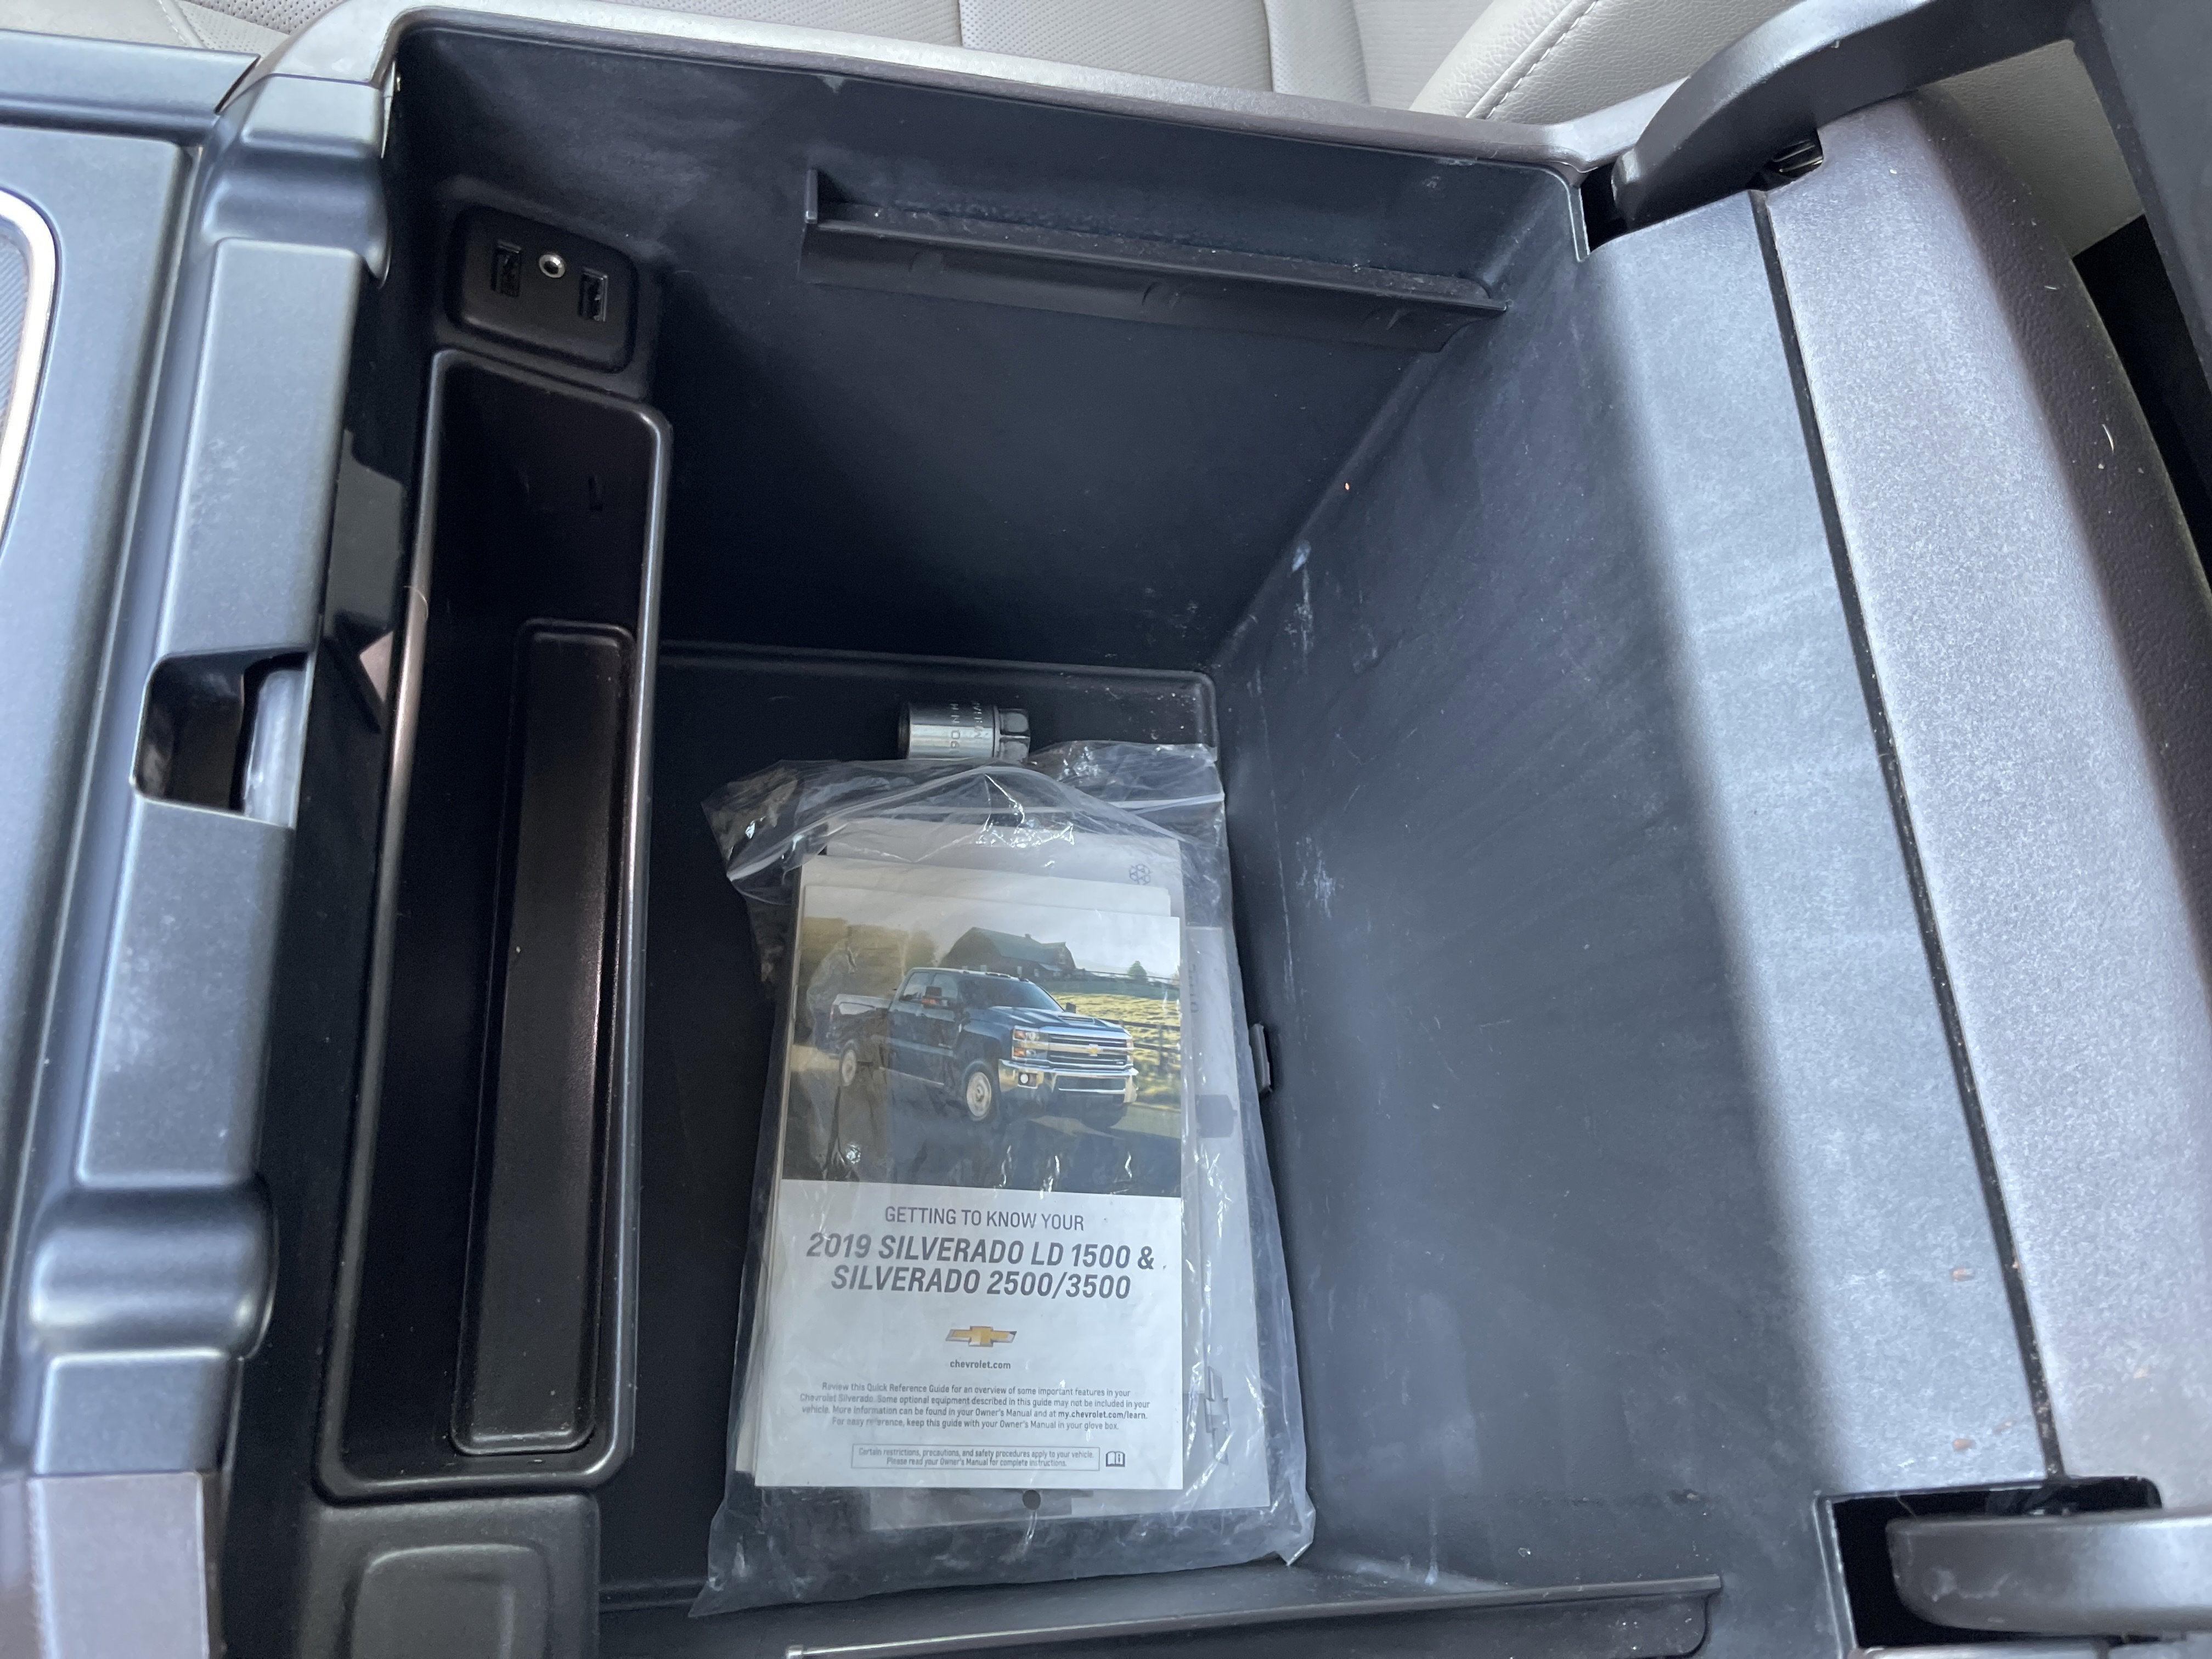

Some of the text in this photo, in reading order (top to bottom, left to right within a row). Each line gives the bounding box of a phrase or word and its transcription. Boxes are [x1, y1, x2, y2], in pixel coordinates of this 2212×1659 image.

[885, 1206, 1084, 1231] GETTING TO KNOW YOUR
[806, 1232, 1154, 1269] 2019 SILVERADO LD 1500 &
[831, 1265, 1130, 1299] SILVERADO 2500/3500
[950, 1359, 1011, 1369] chevrolet.com
[822, 1382, 849, 1391] Review
[867, 1383, 887, 1392] Quick
[889, 1384, 927, 1392] Reference
[929, 1385, 949, 1393] Guide
[1038, 1387, 1073, 1396] important
[1075, 1388, 1104, 1396] features
[1107, 1388, 1113, 1396] in
[1115, 1390, 1130, 1398] your
[800, 1393, 836, 1402] Chevrolet
[900, 1396, 929, 1405] optional
[931, 1397, 970, 1406] equipment
[972, 1397, 1007, 1406] described
[1032, 1398, 1051, 1407] guide
[1084, 1399, 1092, 1407] be
[1094, 1400, 1124, 1408] included
[1134, 1402, 1150, 1410] your
[802, 1404, 830, 1413] vehicle.
[854, 1406, 897, 1414] information
[975, 1408, 1004, 1417] Owner's
[1058, 1410, 1148, 1420] my.chevrolet.com/learn.
[907, 1418, 924, 1428] keep
[927, 1419, 940, 1427] this
[942, 1419, 962, 1429] guide
[964, 1419, 979, 1427] with
[981, 1421, 998, 1429] your
[1084, 1422, 1103, 1431] glove
[923, 1449, 960, 1458] precautions,
[975, 1449, 994, 1459] safety
[924, 1459, 938, 1467] your
[990, 1457, 998, 1465] for
[1000, 1459, 1028, 1468] complete
